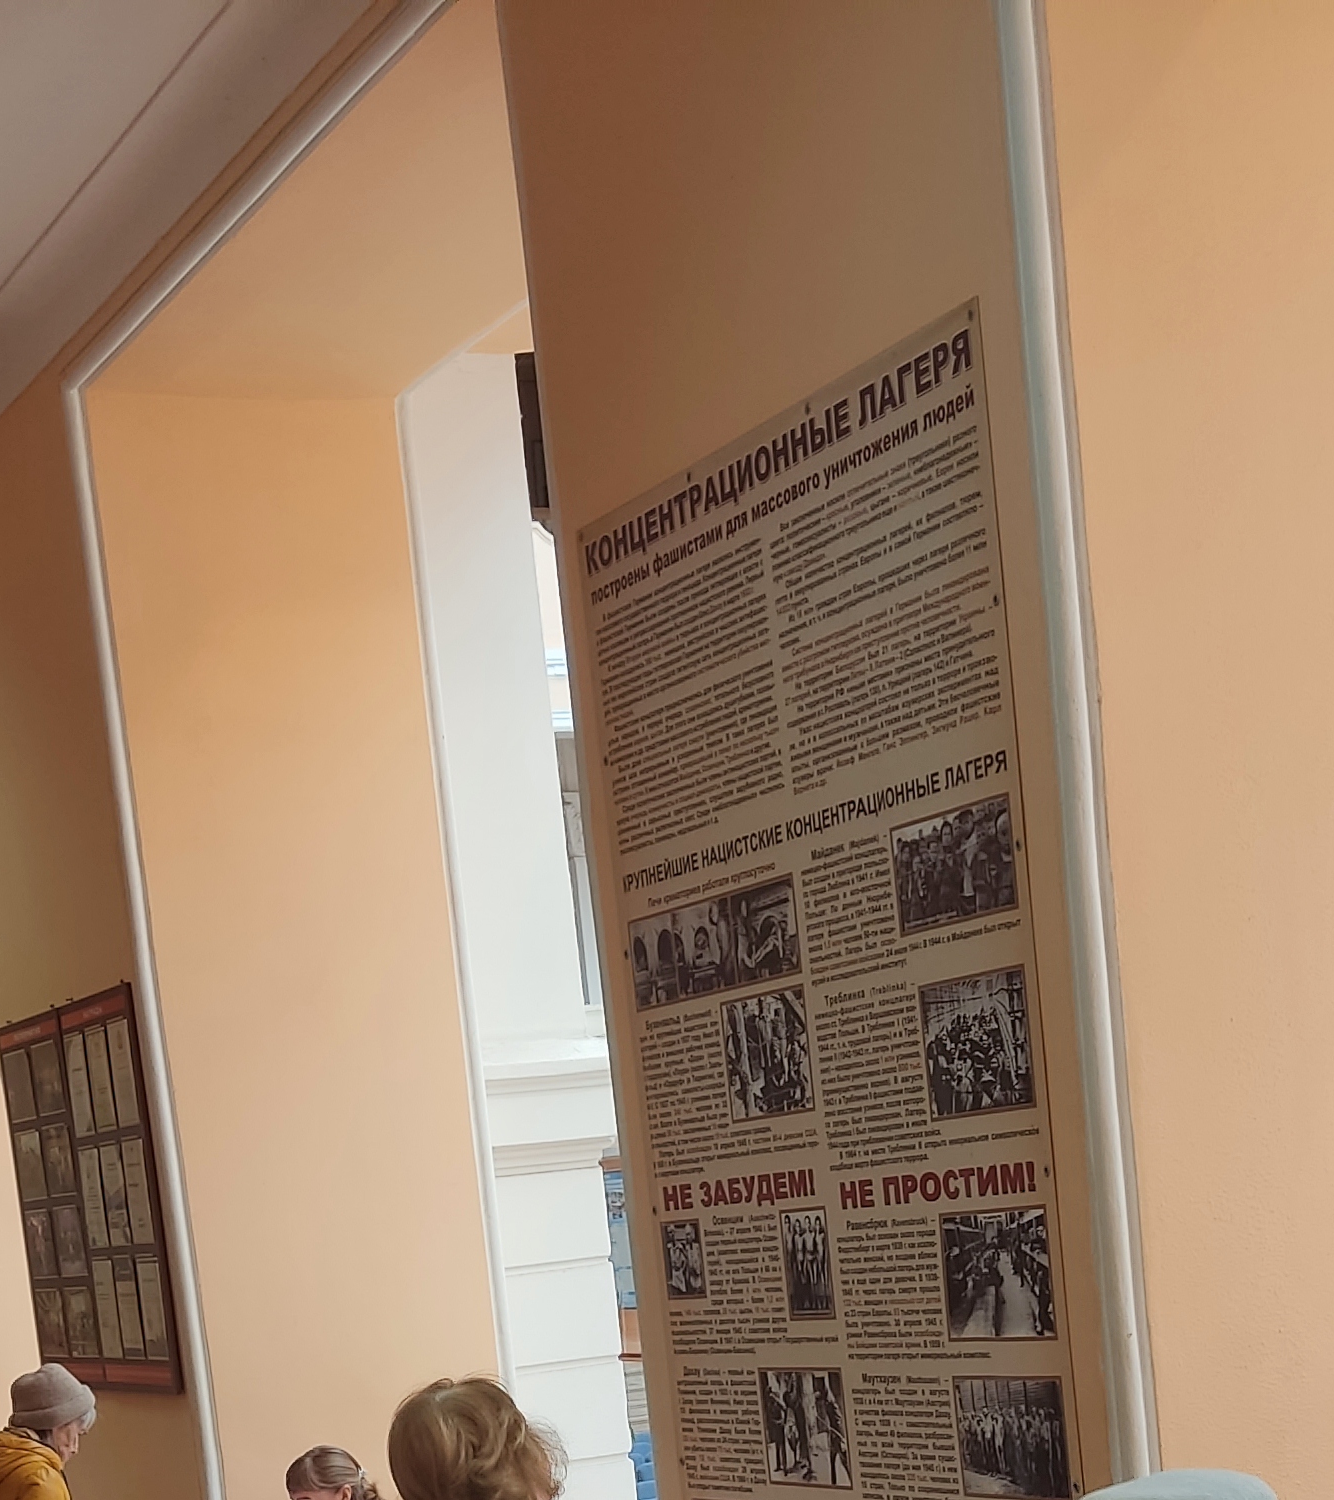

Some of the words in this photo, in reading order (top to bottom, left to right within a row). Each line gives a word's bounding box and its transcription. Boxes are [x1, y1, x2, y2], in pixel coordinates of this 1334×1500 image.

[584, 400, 851, 575] КОНЦЕНТРАЦИОННЫЕ
[858, 328, 973, 429] ЛАГЕРЯ
[591, 562, 650, 610] построены
[652, 520, 723, 579] фашистами
[724, 509, 748, 539] для
[751, 470, 820, 522] массового
[823, 417, 919, 489] уничтожения
[921, 384, 975, 438] людей
[700, 823, 783, 871] НАЦИСТСКИЕ
[784, 771, 941, 843] КОНЦЕНТРАЦИОННЫЕ
[943, 748, 1007, 790] ЛАГЕРЯ
[661, 1183, 694, 1212] НЕ
[698, 1169, 816, 1209] ЗАБУДЕМ!
[838, 1178, 875, 1209] НЕ
[881, 1161, 1037, 1206] ПРОСТИМ!
